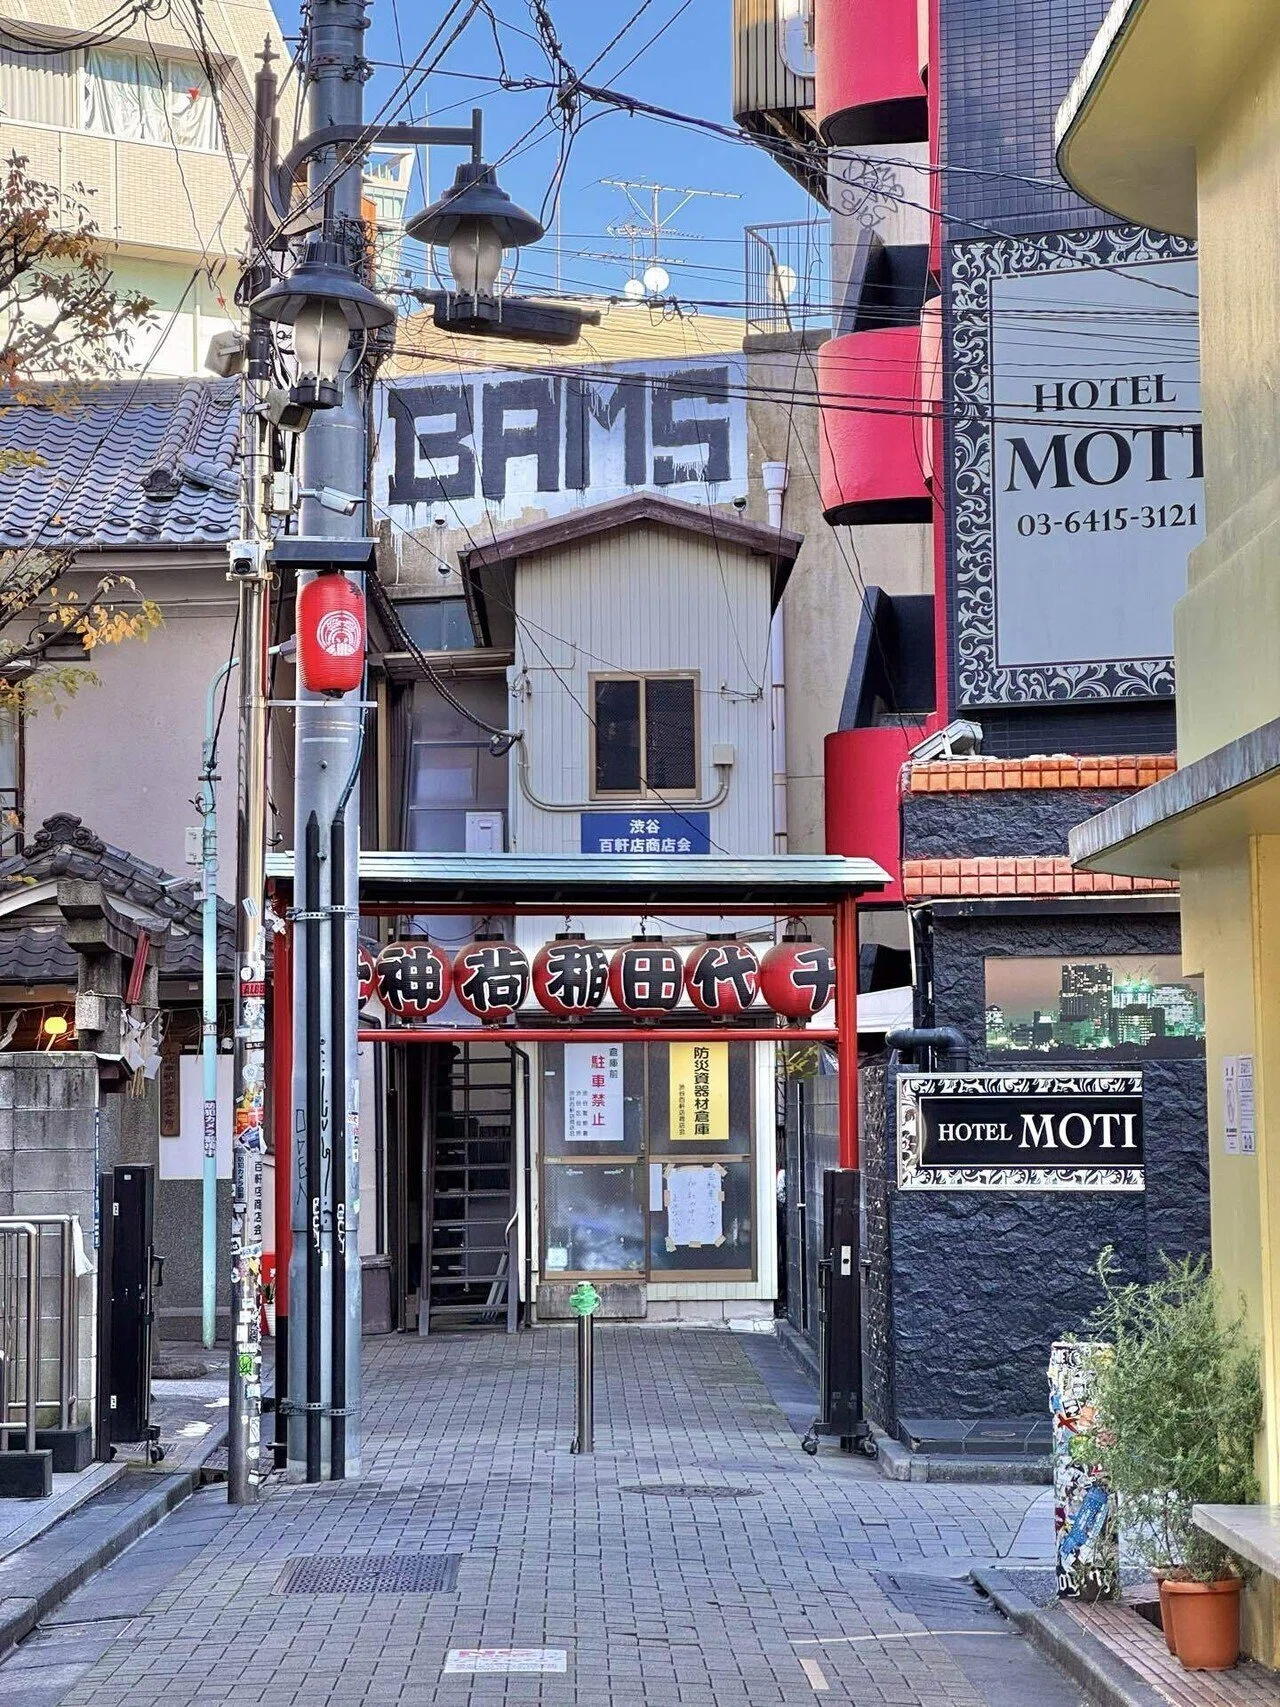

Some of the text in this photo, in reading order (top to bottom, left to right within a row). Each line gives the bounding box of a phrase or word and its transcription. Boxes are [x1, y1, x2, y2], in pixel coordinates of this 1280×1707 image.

[1033, 373, 1177, 413] HOTEL
[1003, 425, 1204, 492] MOTI
[1017, 503, 1199, 536] 03-6415-3121
[598, 837, 691, 852] 百軒店商店会
[629, 819, 660, 834] 渋谷
[591, 1055, 605, 1126] 駐車禁止
[694, 1047, 709, 1135] 防災資器材倉庫
[938, 1113, 1137, 1149] HOTEL MOTI
[254, 1161, 262, 1235] 百軒店商店会
